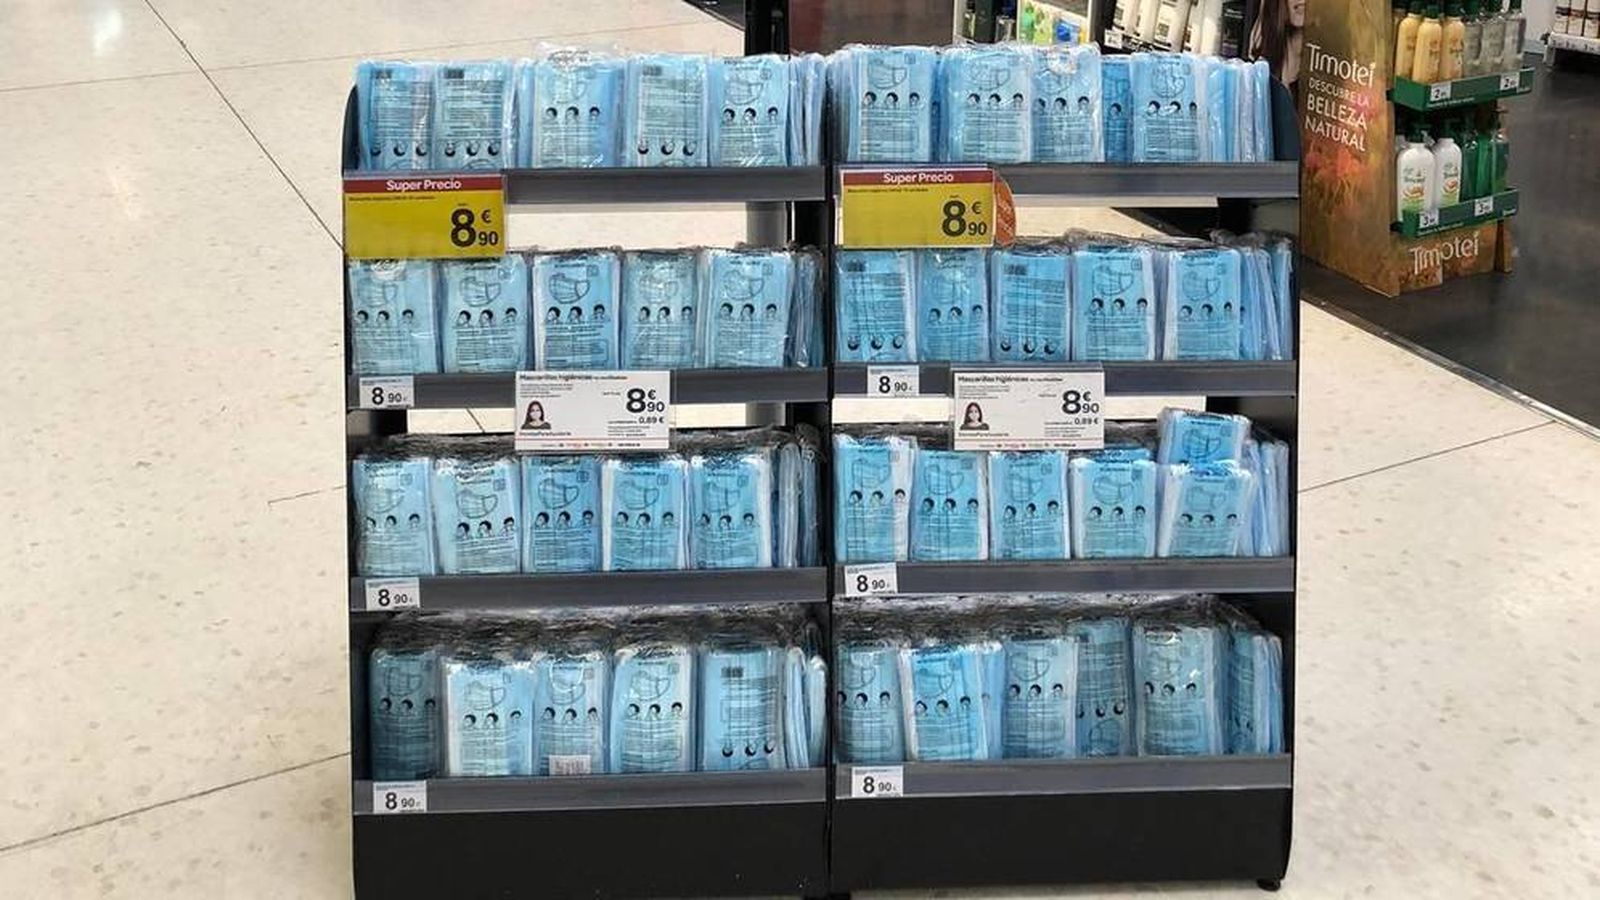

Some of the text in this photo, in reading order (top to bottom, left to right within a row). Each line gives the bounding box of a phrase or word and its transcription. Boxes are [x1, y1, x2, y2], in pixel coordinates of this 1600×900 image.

[1306, 42, 1376, 89] Timotei
[1309, 77, 1370, 107] DESCUBRE LA
[1307, 93, 1367, 130] BELLEZA
[1305, 115, 1366, 152] NATURAL
[386, 178, 462, 192] Super Precio
[883, 171, 954, 185] Super Precio
[481, 210, 491, 223] €
[971, 201, 982, 215] €
[451, 208, 499, 247] 8 90
[942, 200, 987, 237] 8 90
[1410, 231, 1479, 275] Timotei
[879, 376, 890, 394] 8
[372, 387, 384, 405] 8
[626, 388, 665, 413] 8 90
[647, 389, 657, 400] €
[1061, 390, 1100, 415] 8 90
[857, 574, 868, 592] 8
[378, 589, 390, 607] 8
[863, 776, 874, 794] 8
[385, 792, 397, 810] 8
